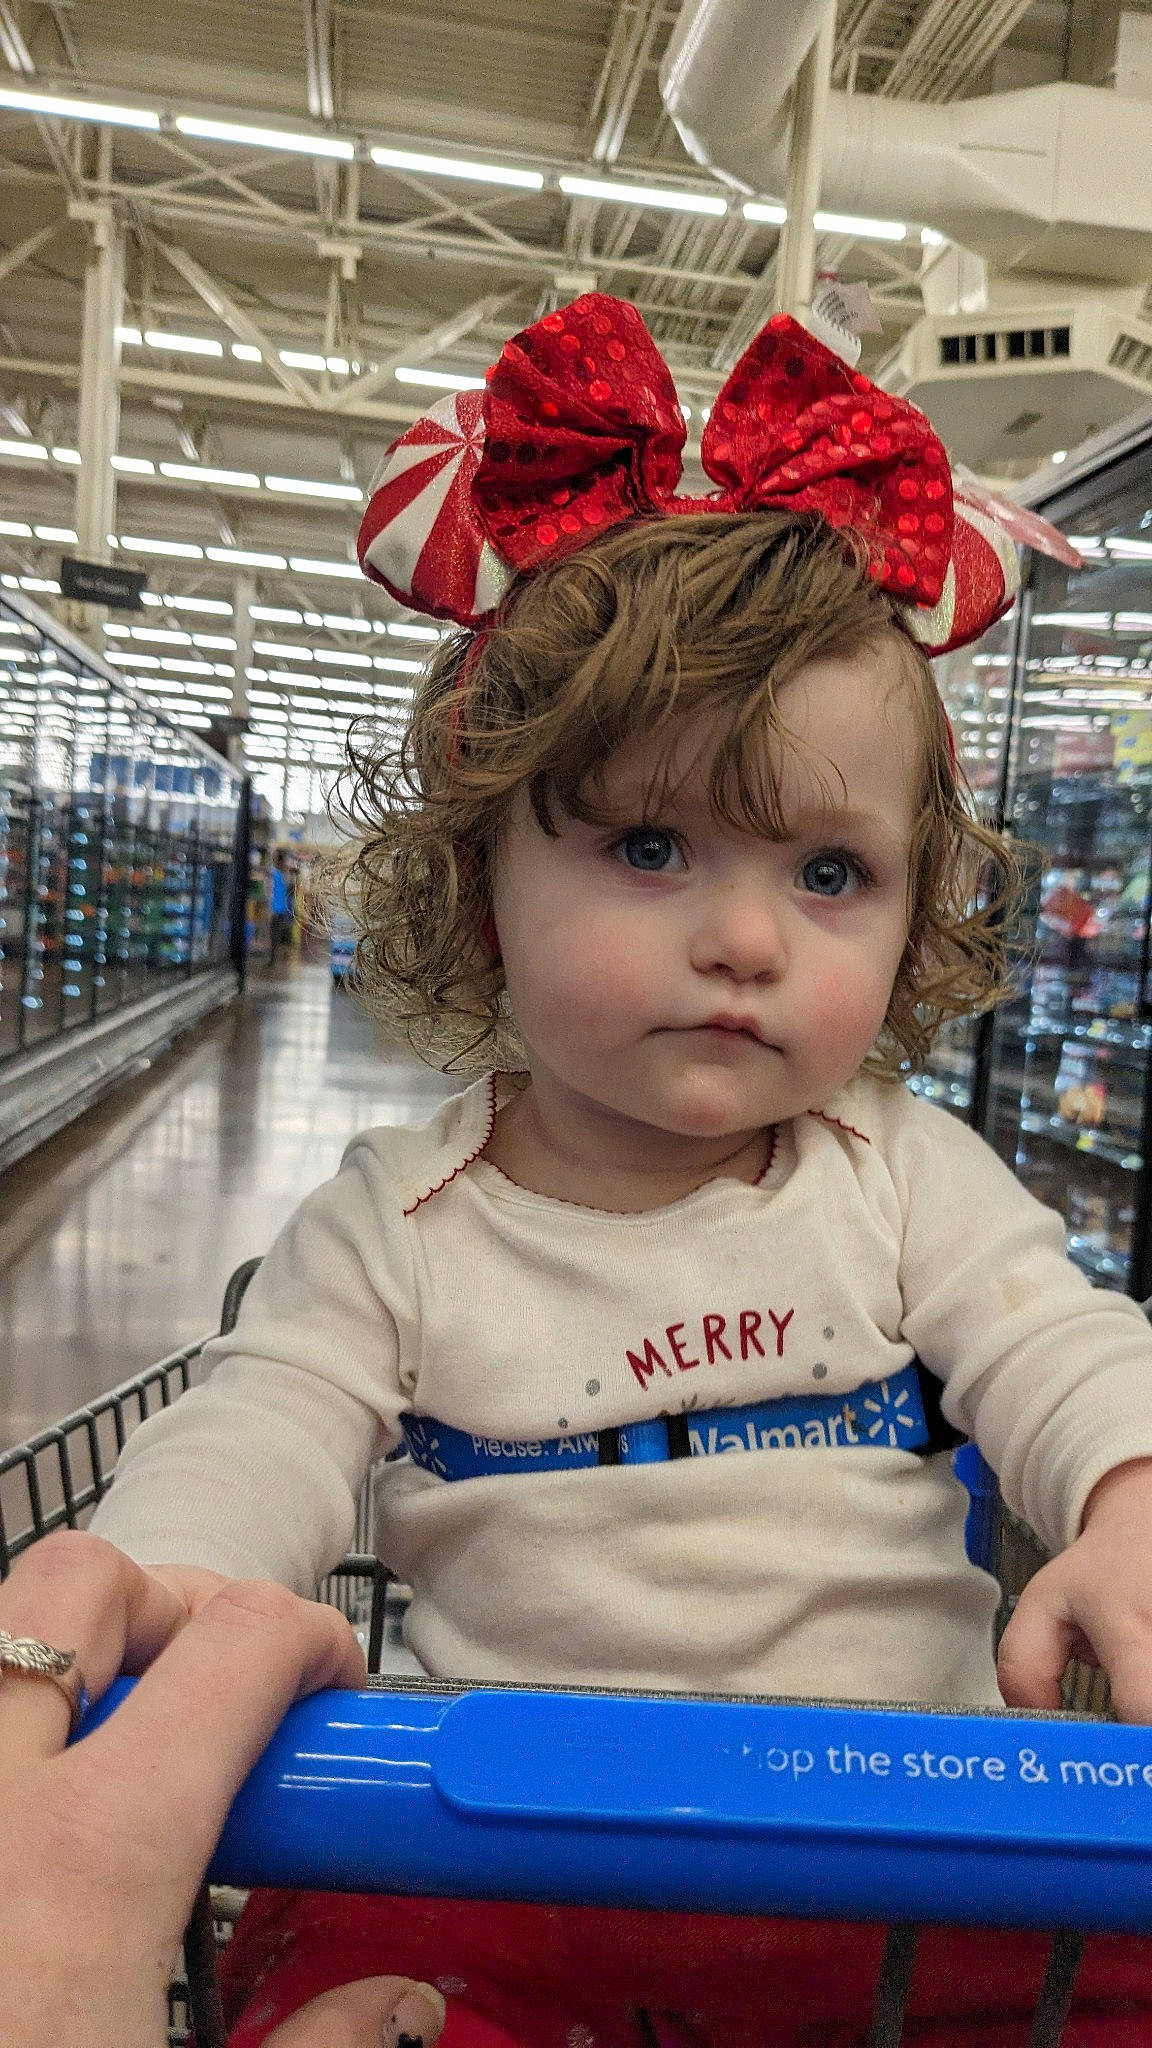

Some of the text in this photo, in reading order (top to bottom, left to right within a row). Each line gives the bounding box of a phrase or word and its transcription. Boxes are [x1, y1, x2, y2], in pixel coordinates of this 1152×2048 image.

[626, 1308, 795, 1391] MERRY
[736, 1744, 814, 1782] op
[827, 1743, 891, 1776] the
[903, 1750, 1006, 1782] store
[1018, 1748, 1049, 1783] &
